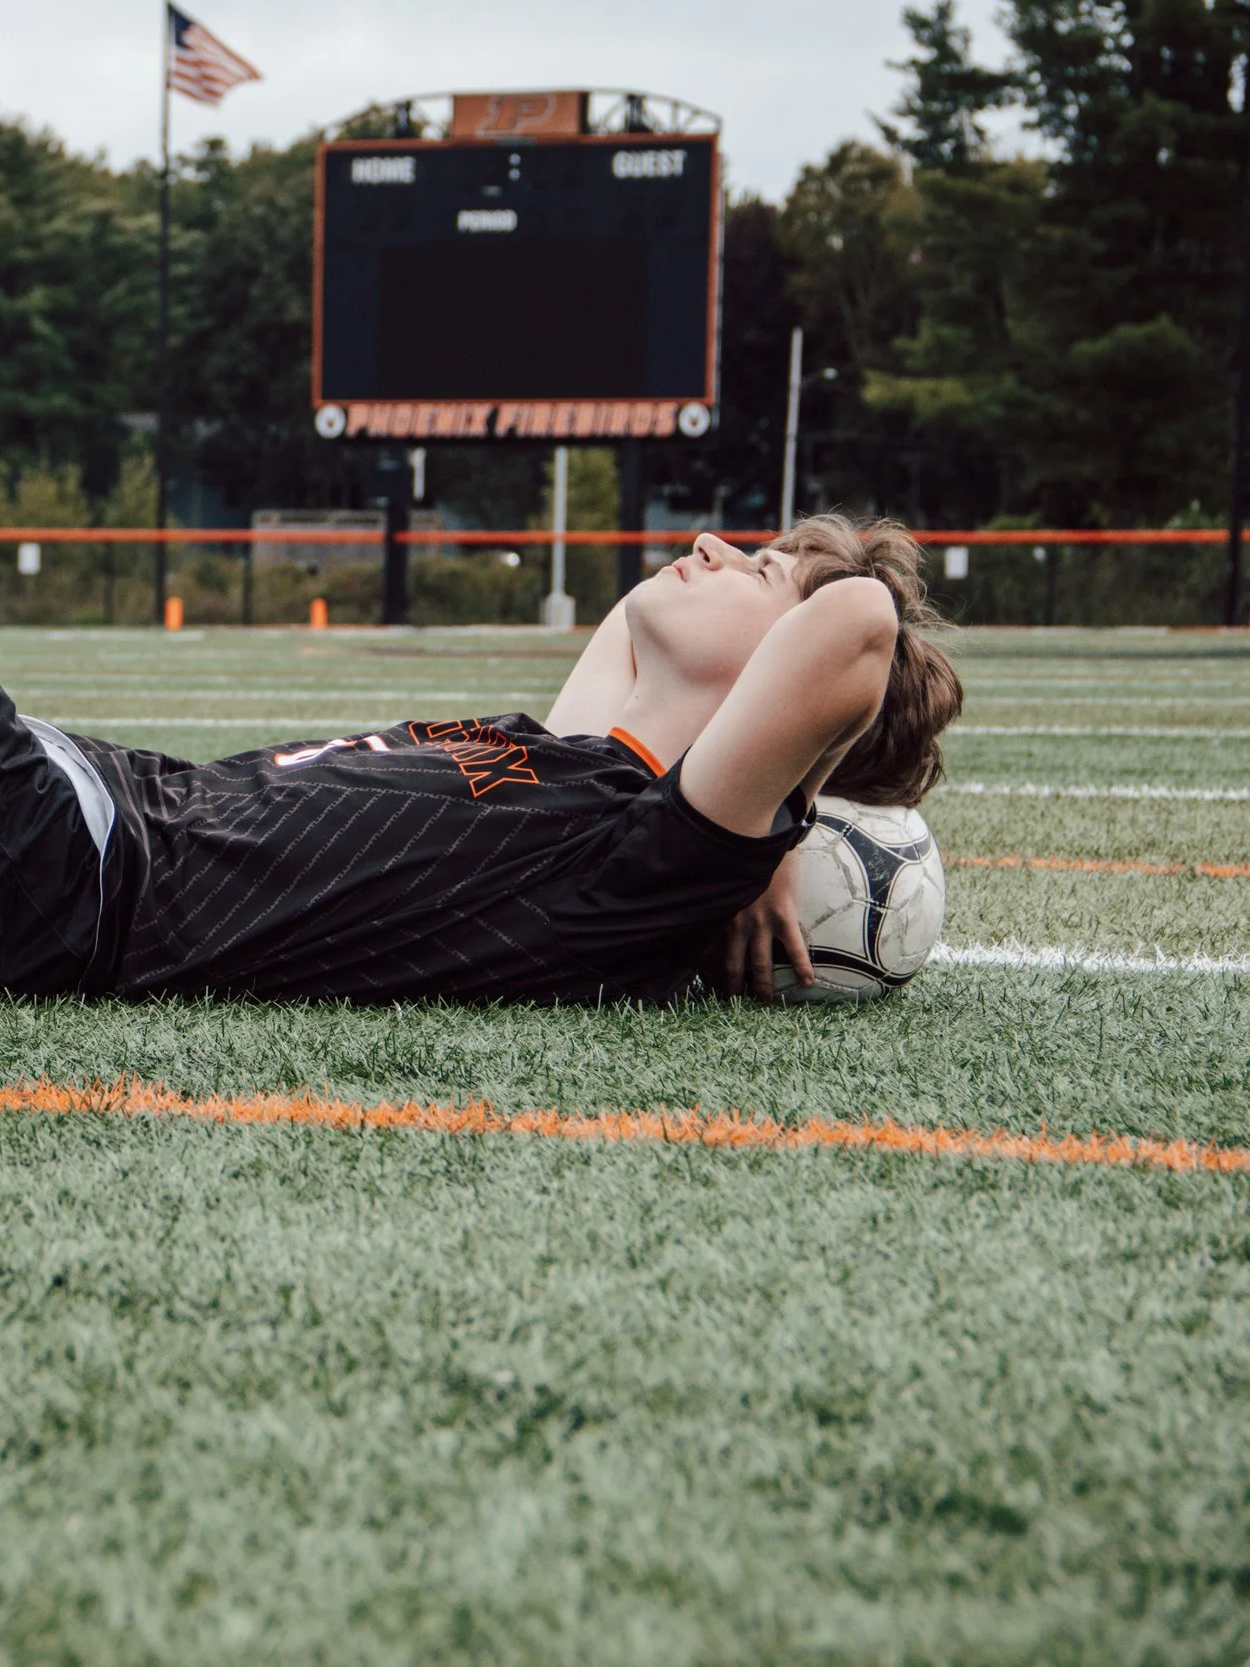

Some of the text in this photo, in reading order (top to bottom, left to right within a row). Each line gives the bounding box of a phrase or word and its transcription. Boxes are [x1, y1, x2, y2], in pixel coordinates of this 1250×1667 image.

[351, 156, 417, 184] HOME
[612, 150, 687, 178] GUEST
[346, 402, 678, 438] PHOENIX FIREBIRDS
